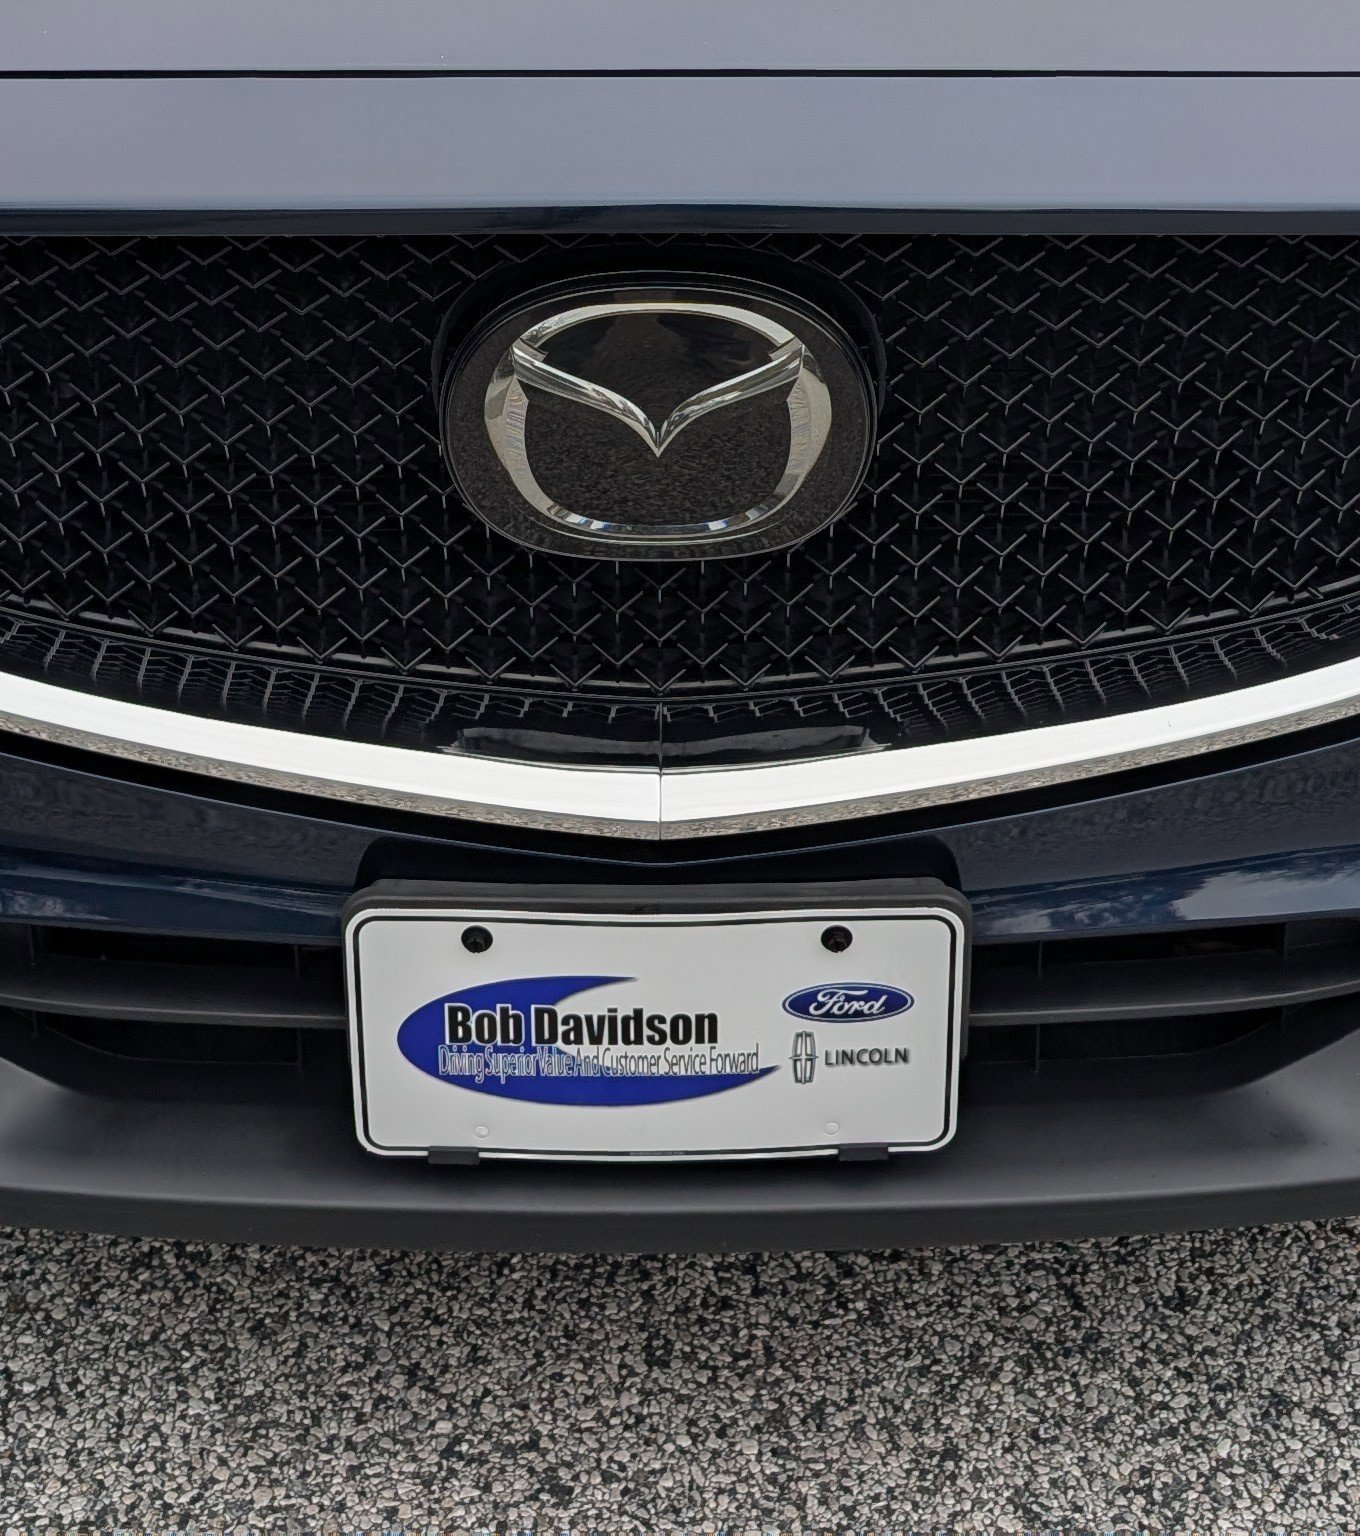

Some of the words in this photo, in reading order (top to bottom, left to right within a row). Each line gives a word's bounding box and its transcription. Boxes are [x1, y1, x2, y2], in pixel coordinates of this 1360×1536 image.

[808, 988, 889, 1016] Ford
[445, 1003, 525, 1046] Bob
[532, 1005, 719, 1046] Davidson
[438, 1045, 485, 1084] Driving
[485, 1045, 537, 1084] Superior
[537, 1046, 573, 1076] Value
[573, 1046, 600, 1076] And
[602, 1047, 662, 1076] Customer
[663, 1046, 707, 1076] Service
[709, 1043, 760, 1075] Forward
[824, 1047, 909, 1066] LINCOLN
